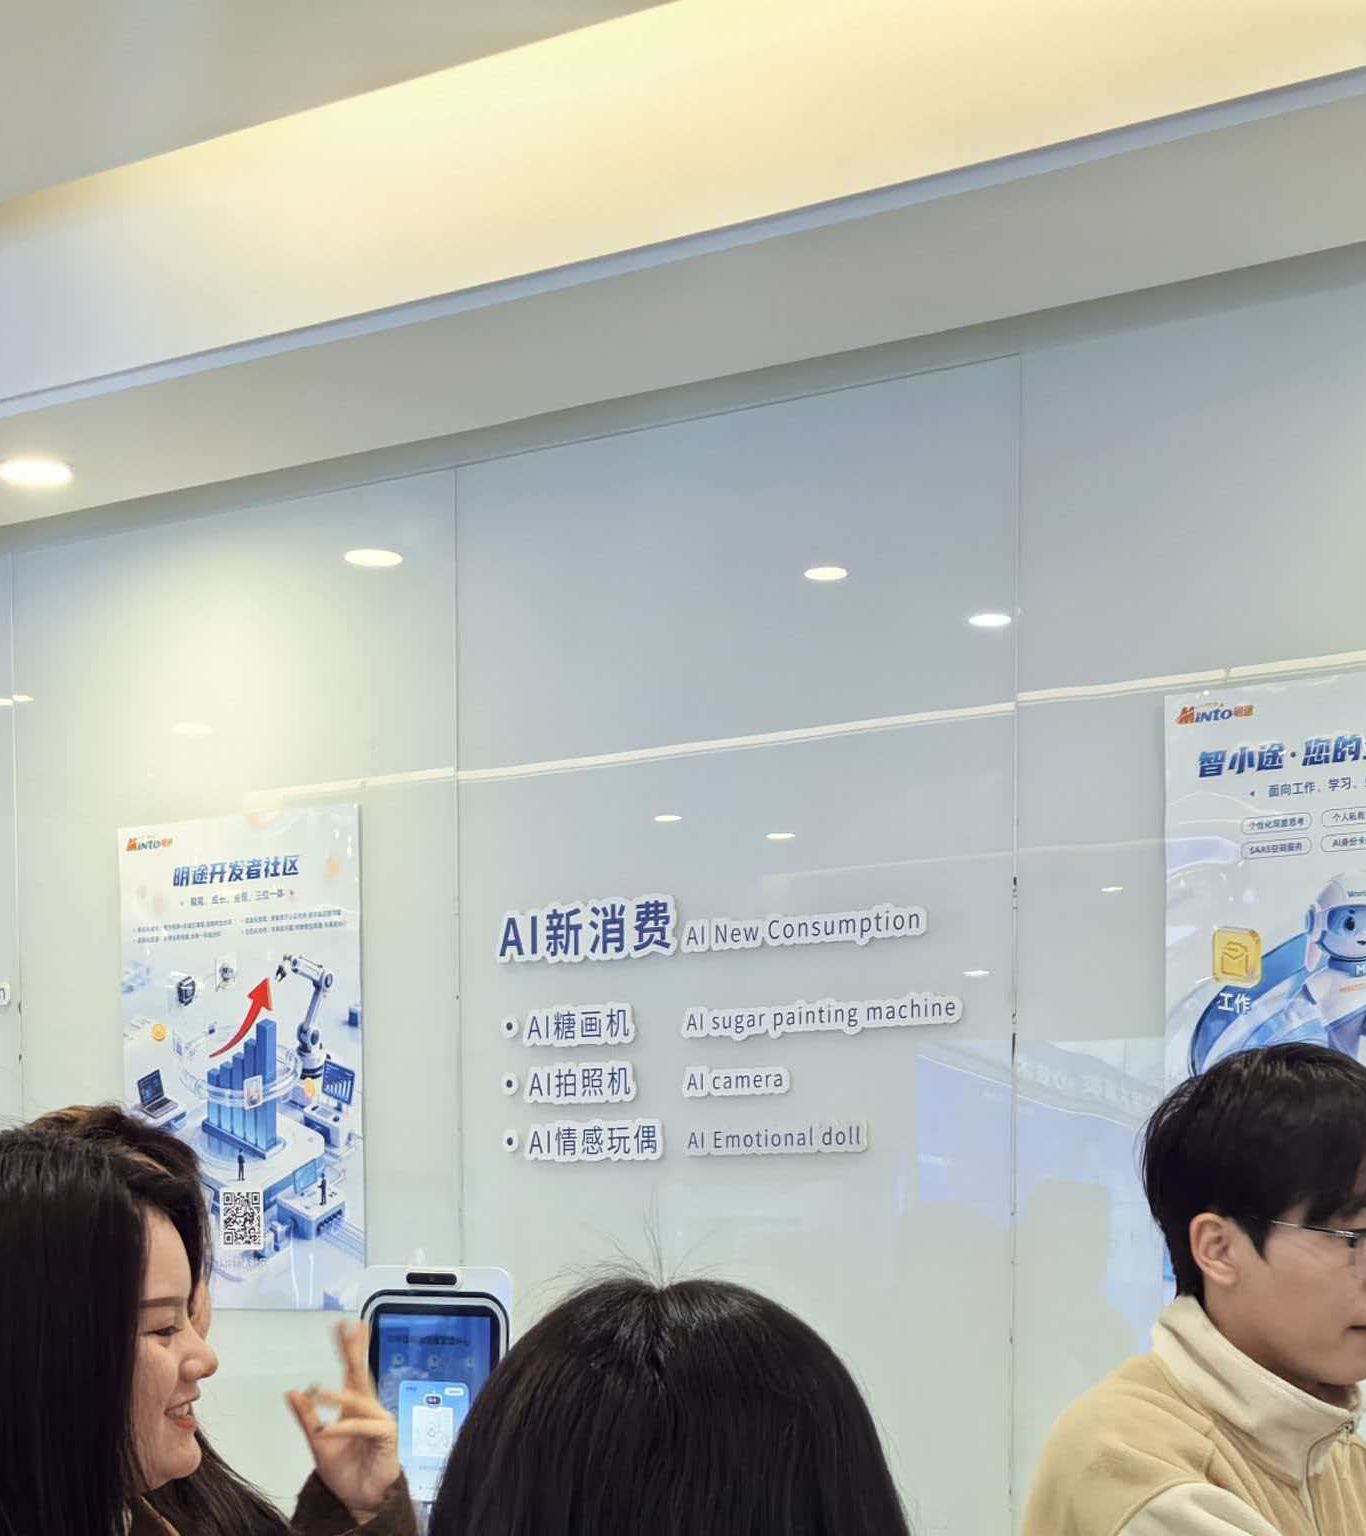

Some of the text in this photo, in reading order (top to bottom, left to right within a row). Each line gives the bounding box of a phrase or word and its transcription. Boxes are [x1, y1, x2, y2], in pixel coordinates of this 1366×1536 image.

[173, 854, 300, 887] 明途开发者社区
[498, 899, 672, 957] AI新消费
[686, 908, 921, 946] AI New Consumption
[686, 997, 956, 1036] AI sugar painting machine
[1216, 993, 1252, 1014] 工作
[527, 1007, 630, 1040] AI糖画机
[528, 1066, 631, 1098] AI拍照机
[686, 1072, 784, 1091] AI camera
[528, 1125, 657, 1155] AI情感玩偶
[687, 1123, 861, 1149] AI Emotional doll
